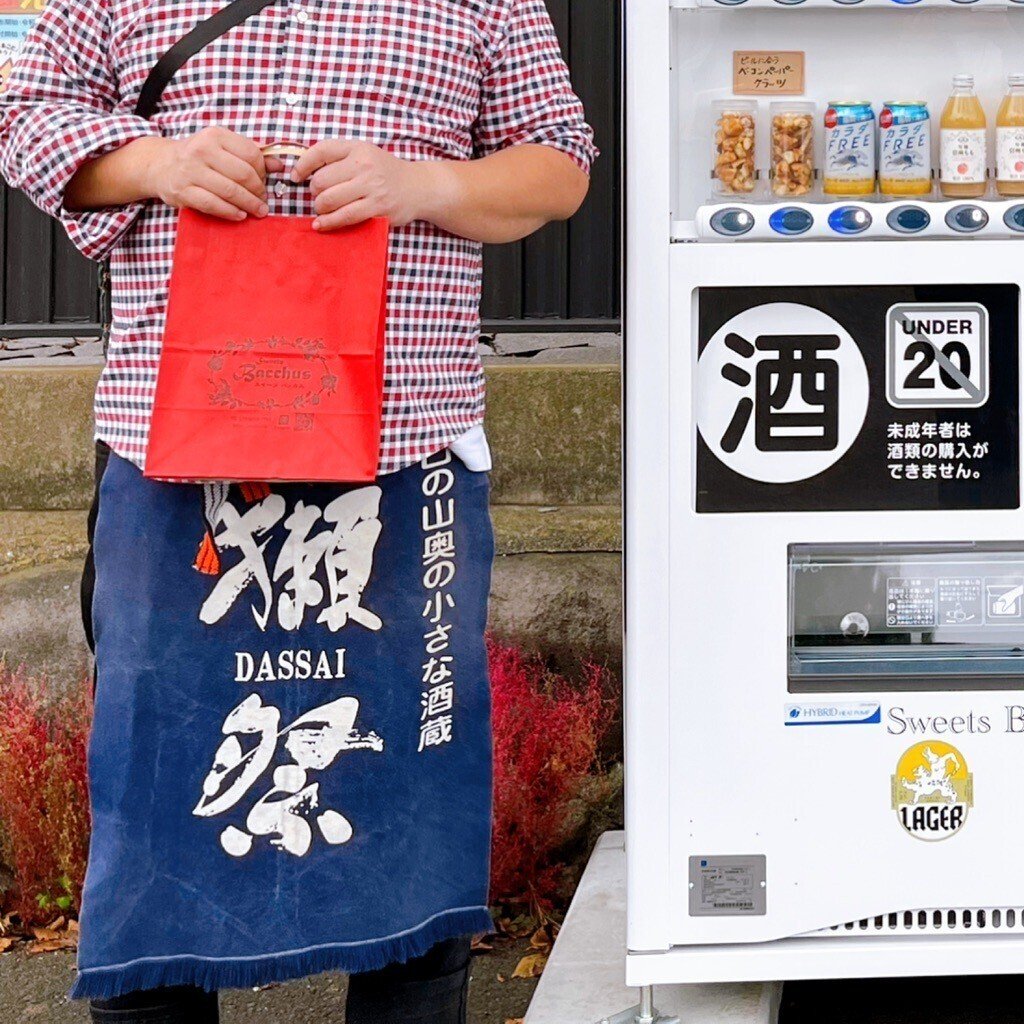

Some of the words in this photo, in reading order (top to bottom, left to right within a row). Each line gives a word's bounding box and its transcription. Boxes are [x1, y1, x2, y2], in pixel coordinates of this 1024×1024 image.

[829, 134, 870, 154] FREE
[883, 134, 925, 154] FREE
[901, 320, 972, 335] UNDER
[233, 364, 311, 382] Bacchus
[903, 341, 971, 390] 20
[720, 332, 841, 453] 酒
[887, 422, 971, 439] 未成年者は
[887, 442, 989, 459] 酒類の購入が
[887, 463, 982, 479] できません。
[199, 486, 383, 631] 獺
[234, 648, 346, 683] DASSAI
[803, 707, 838, 716] HYBRID
[886, 706, 992, 735] Sweets
[192, 693, 383, 856] 祭
[899, 805, 963, 831] LAGER
